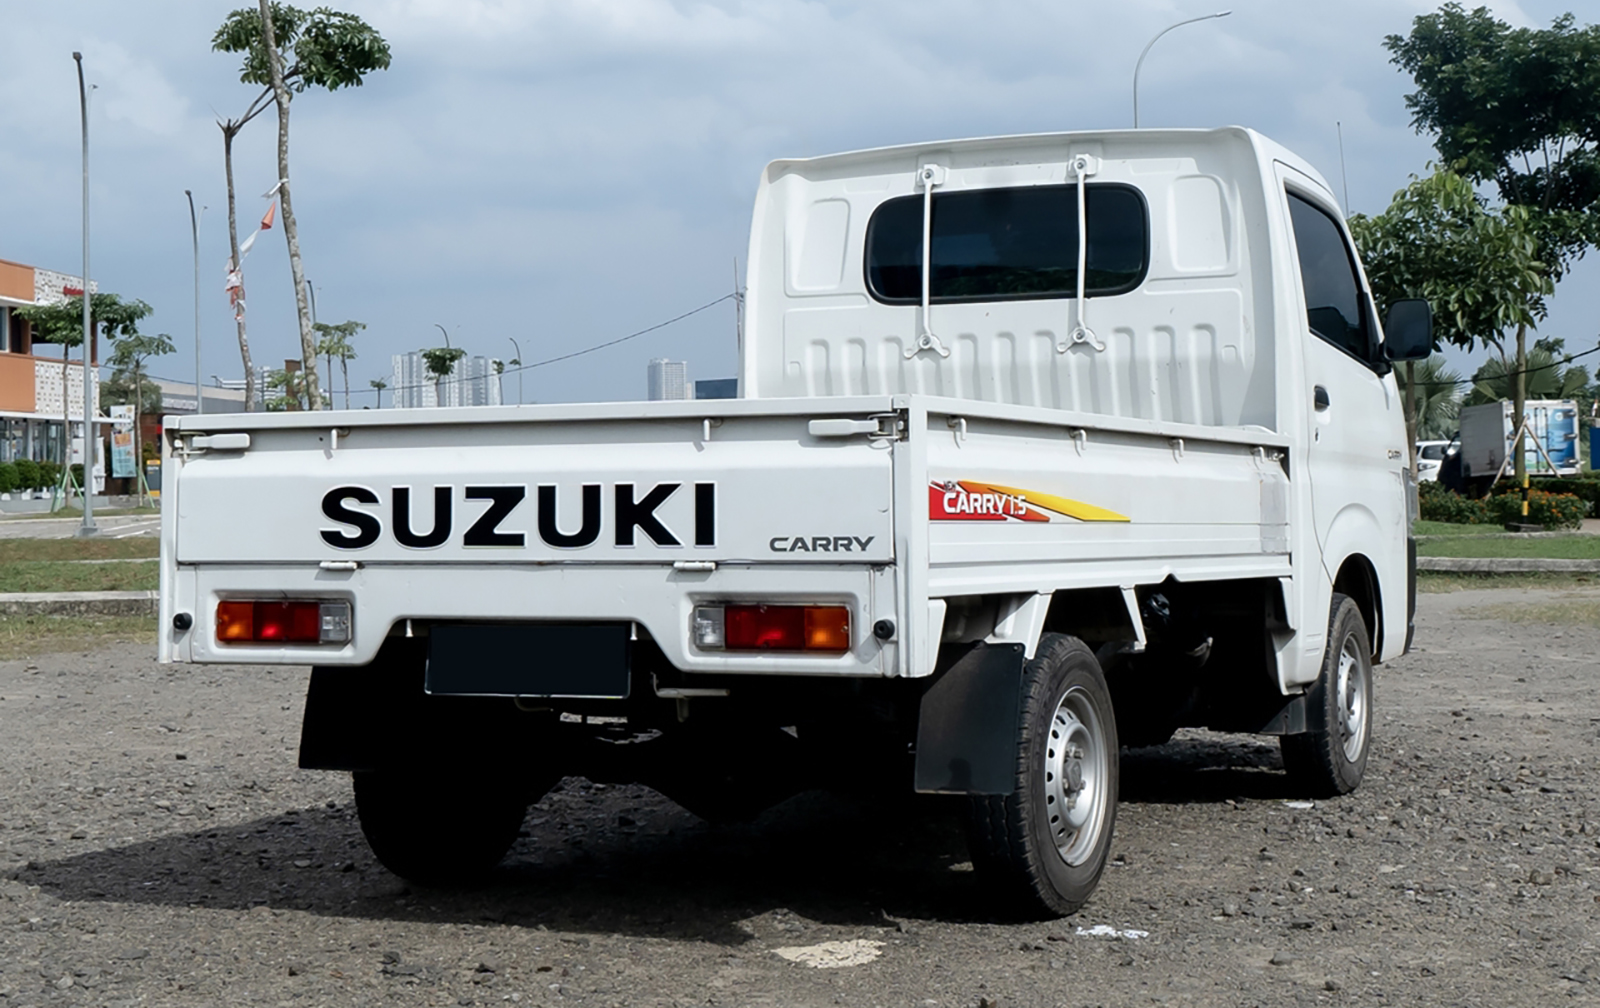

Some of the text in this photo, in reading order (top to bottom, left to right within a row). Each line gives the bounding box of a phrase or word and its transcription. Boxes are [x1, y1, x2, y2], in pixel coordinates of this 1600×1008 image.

[943, 492, 1007, 514] CARRY
[319, 482, 717, 549] SUZUKI
[769, 536, 875, 552] CARRY
